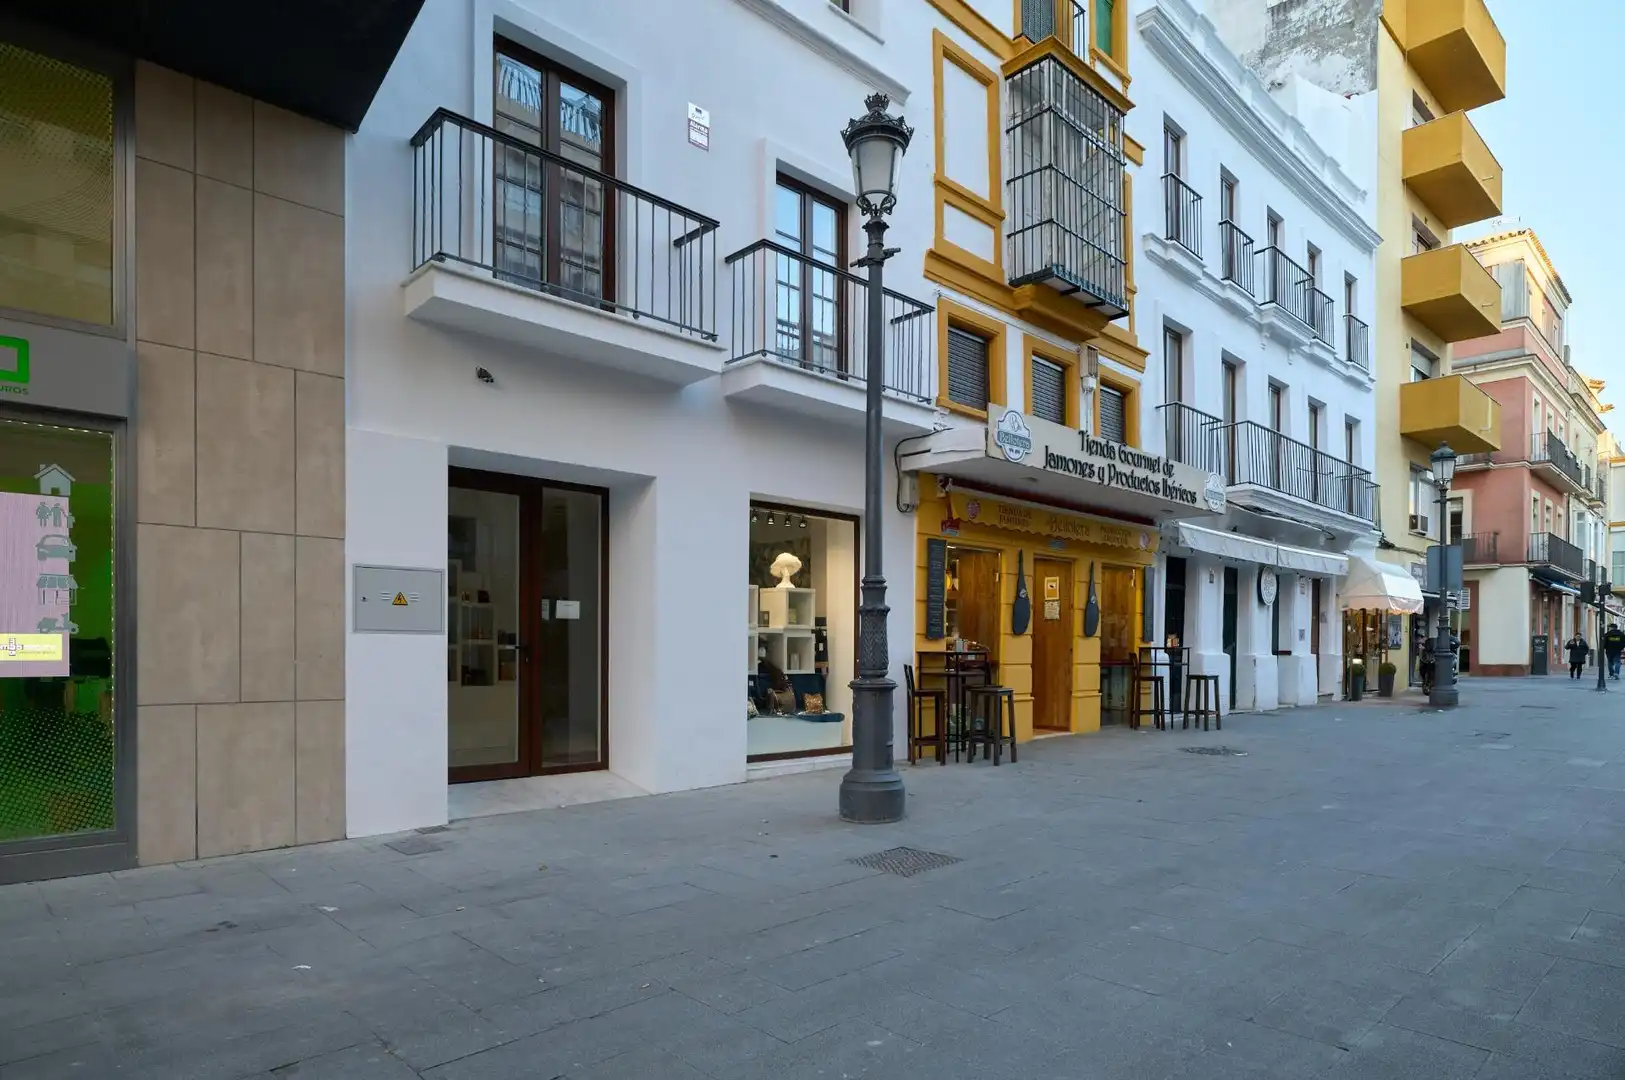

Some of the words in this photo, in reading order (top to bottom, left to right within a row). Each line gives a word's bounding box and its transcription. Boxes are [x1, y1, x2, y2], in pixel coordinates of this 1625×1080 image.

[1043, 445, 1095, 478] Jamones
[1097, 465, 1105, 485] y
[1107, 463, 1161, 495] Productos
[1162, 477, 1197, 504] Ibéricos
[1079, 430, 1116, 461] Tienda
[1118, 441, 1161, 474] Gourmet
[1163, 456, 1175, 479] de
